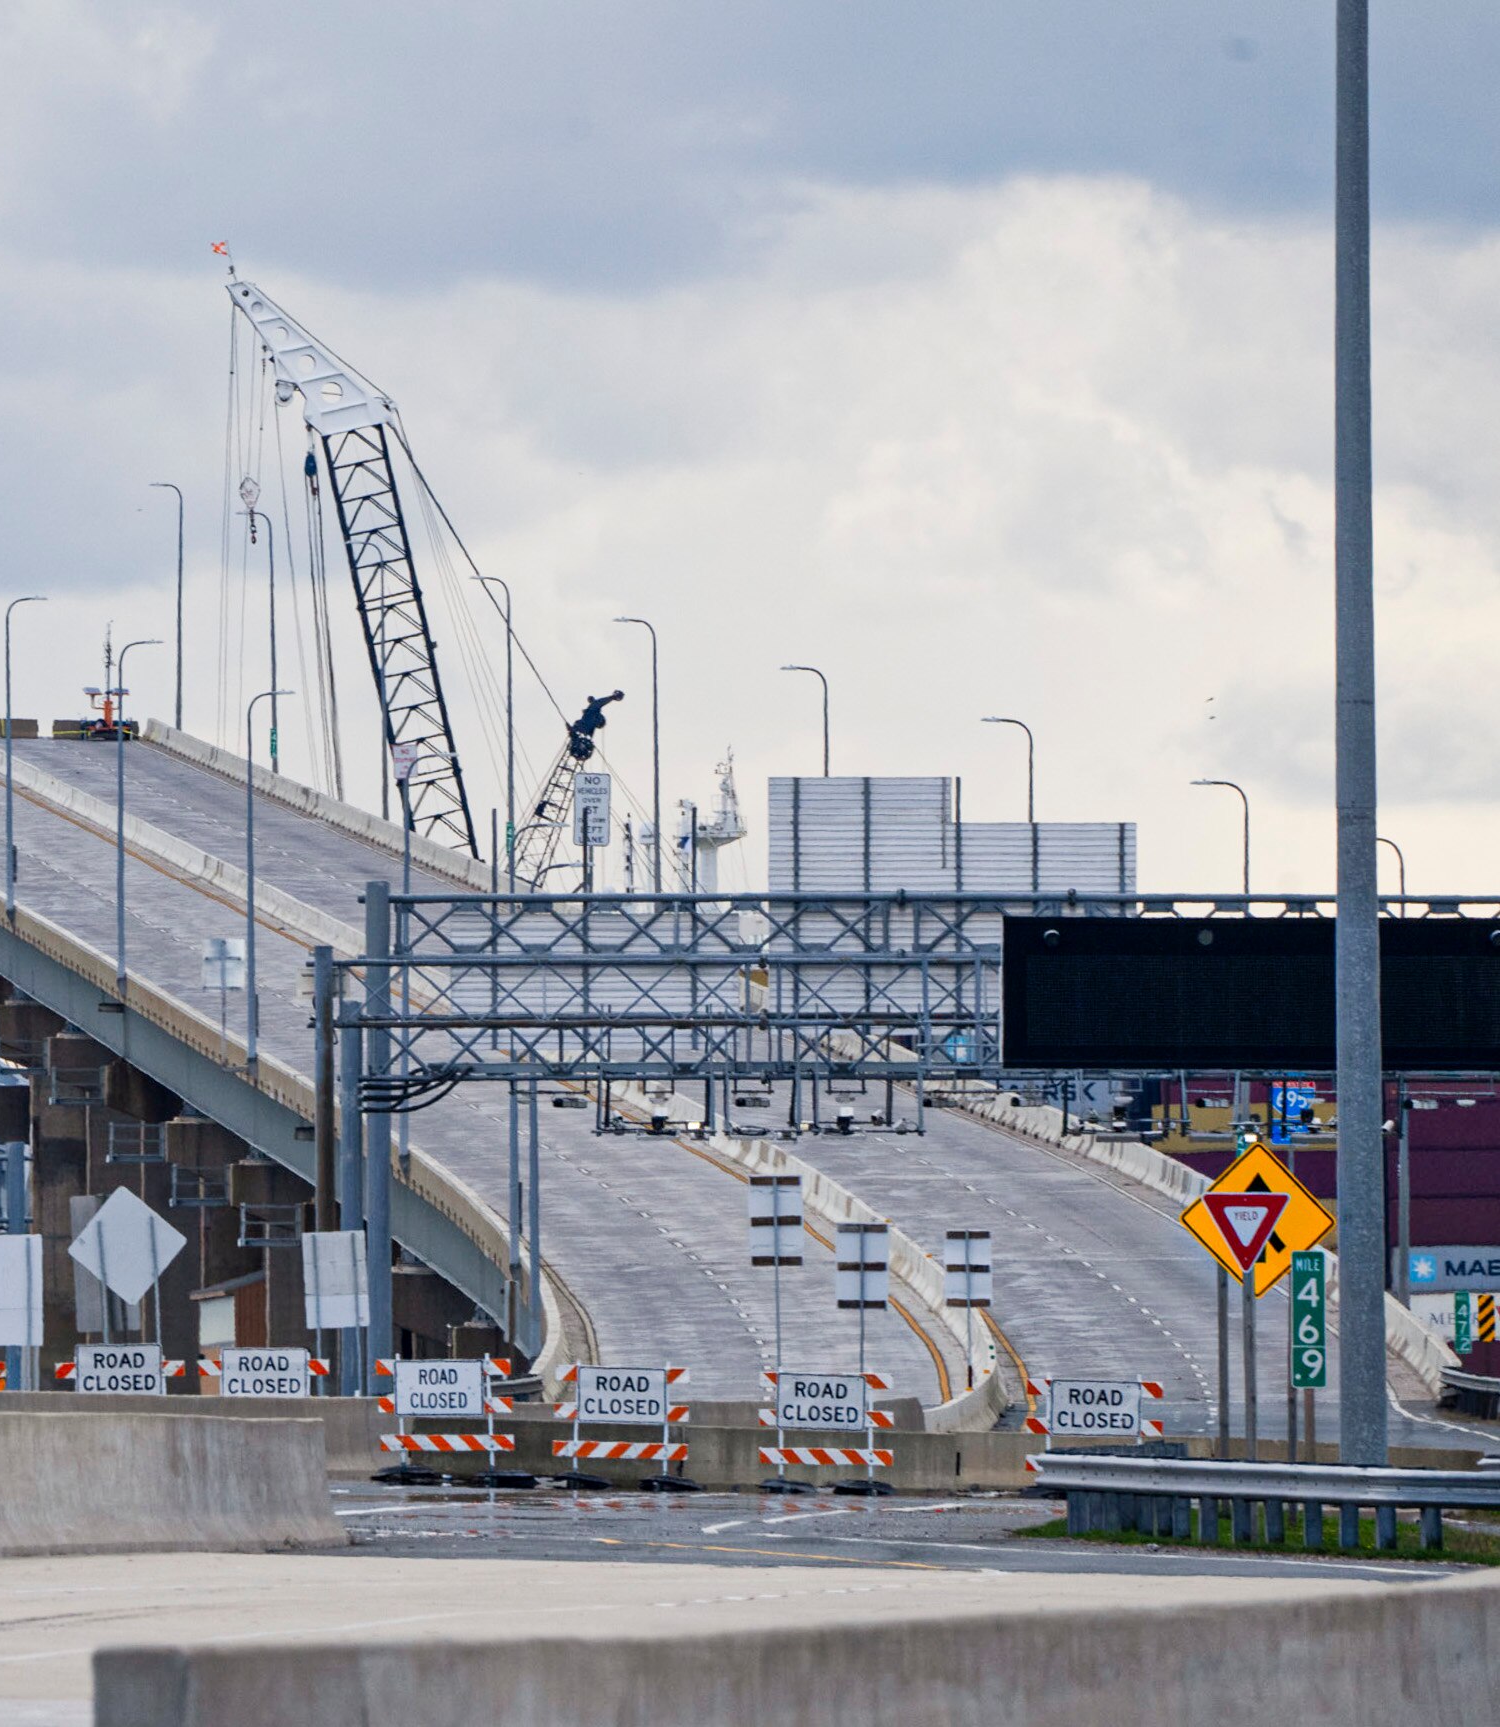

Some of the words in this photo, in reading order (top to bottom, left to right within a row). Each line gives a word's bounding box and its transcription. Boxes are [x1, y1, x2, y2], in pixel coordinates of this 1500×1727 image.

[584, 776, 601, 785] NO
[577, 787, 608, 795] VEHICLES
[1234, 1211, 1258, 1221] YIELD
[1296, 1259, 1321, 1272] MILE
[93, 1352, 145, 1369] ROAD
[238, 1356, 289, 1371] ROAD
[83, 1374, 156, 1391] CLOSED
[418, 1368, 458, 1385] ROAD
[596, 1375, 650, 1392] ROAD
[228, 1378, 301, 1394] CLOSED
[794, 1381, 848, 1399] ROAD
[410, 1392, 468, 1409] CLOSED
[1069, 1388, 1123, 1406] ROAD
[584, 1398, 660, 1415] CLOSED
[783, 1404, 858, 1423] CLOSED
[1057, 1410, 1134, 1429] CLOSED
